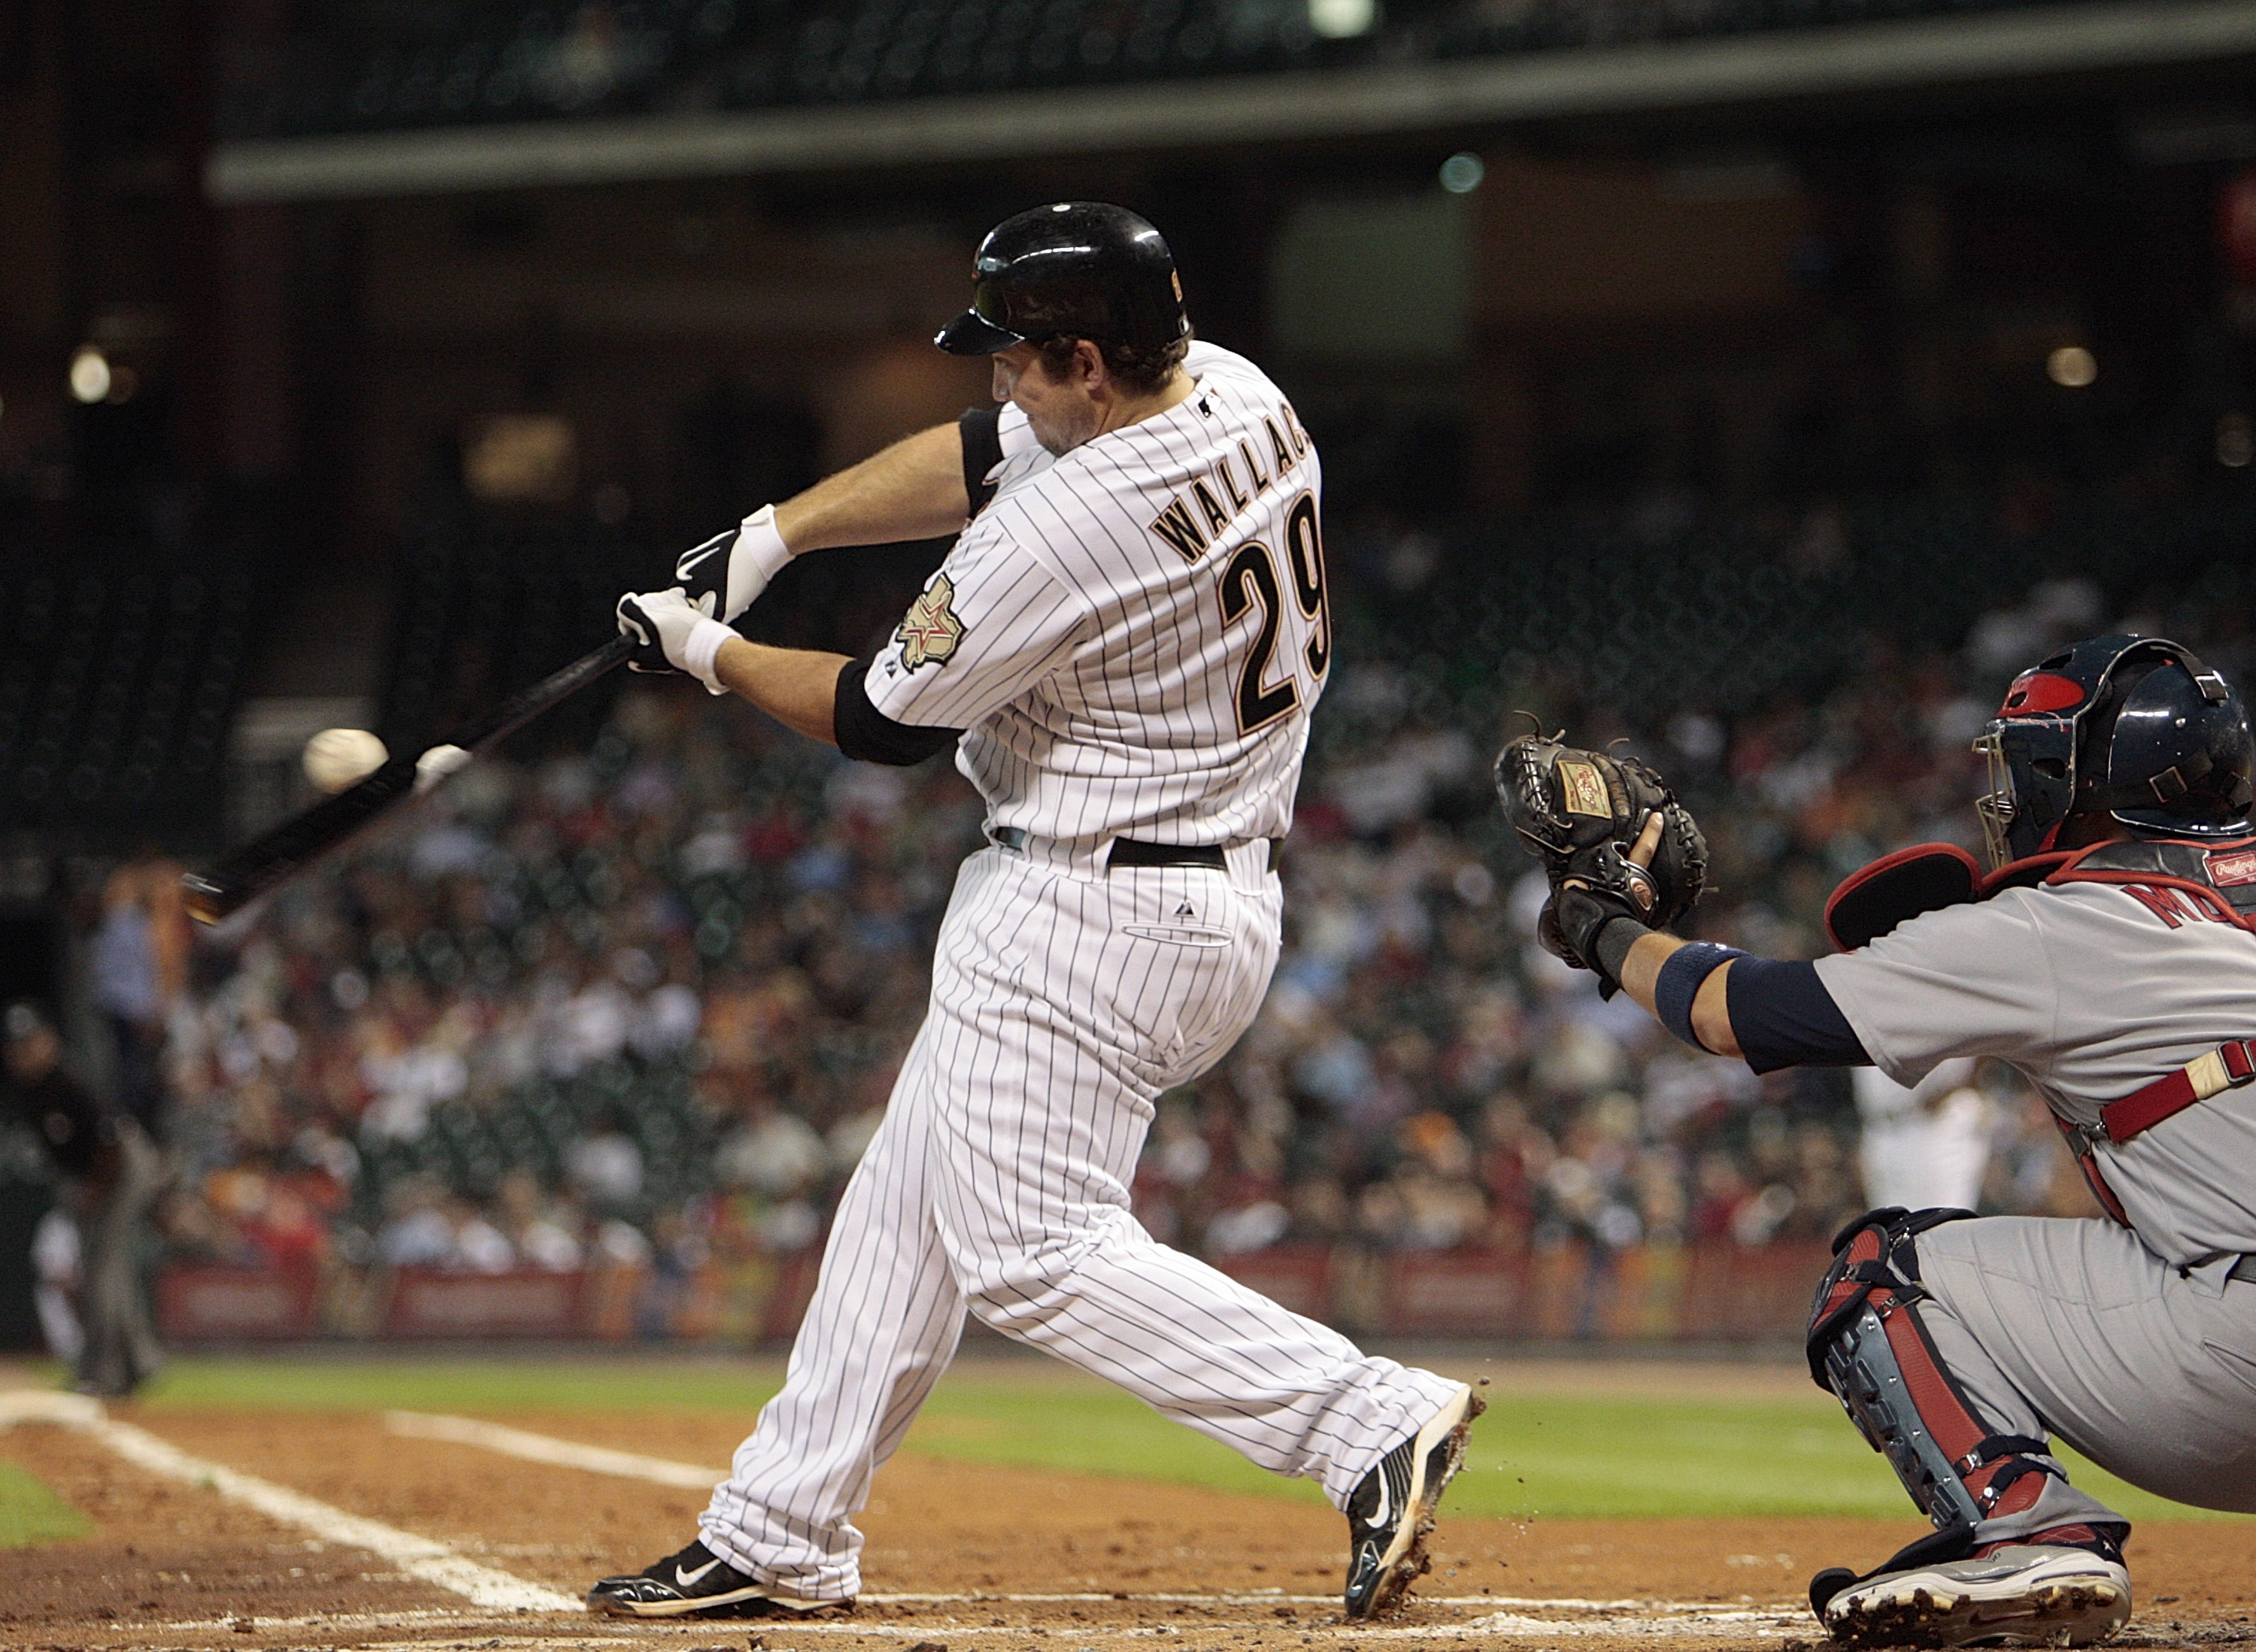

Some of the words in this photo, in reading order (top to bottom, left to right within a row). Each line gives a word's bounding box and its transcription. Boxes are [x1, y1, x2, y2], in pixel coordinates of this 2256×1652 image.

[1149, 399, 1312, 566] WALLAC
[1217, 488, 1332, 738] 29
[2215, 859, 2256, 877] Rawling
